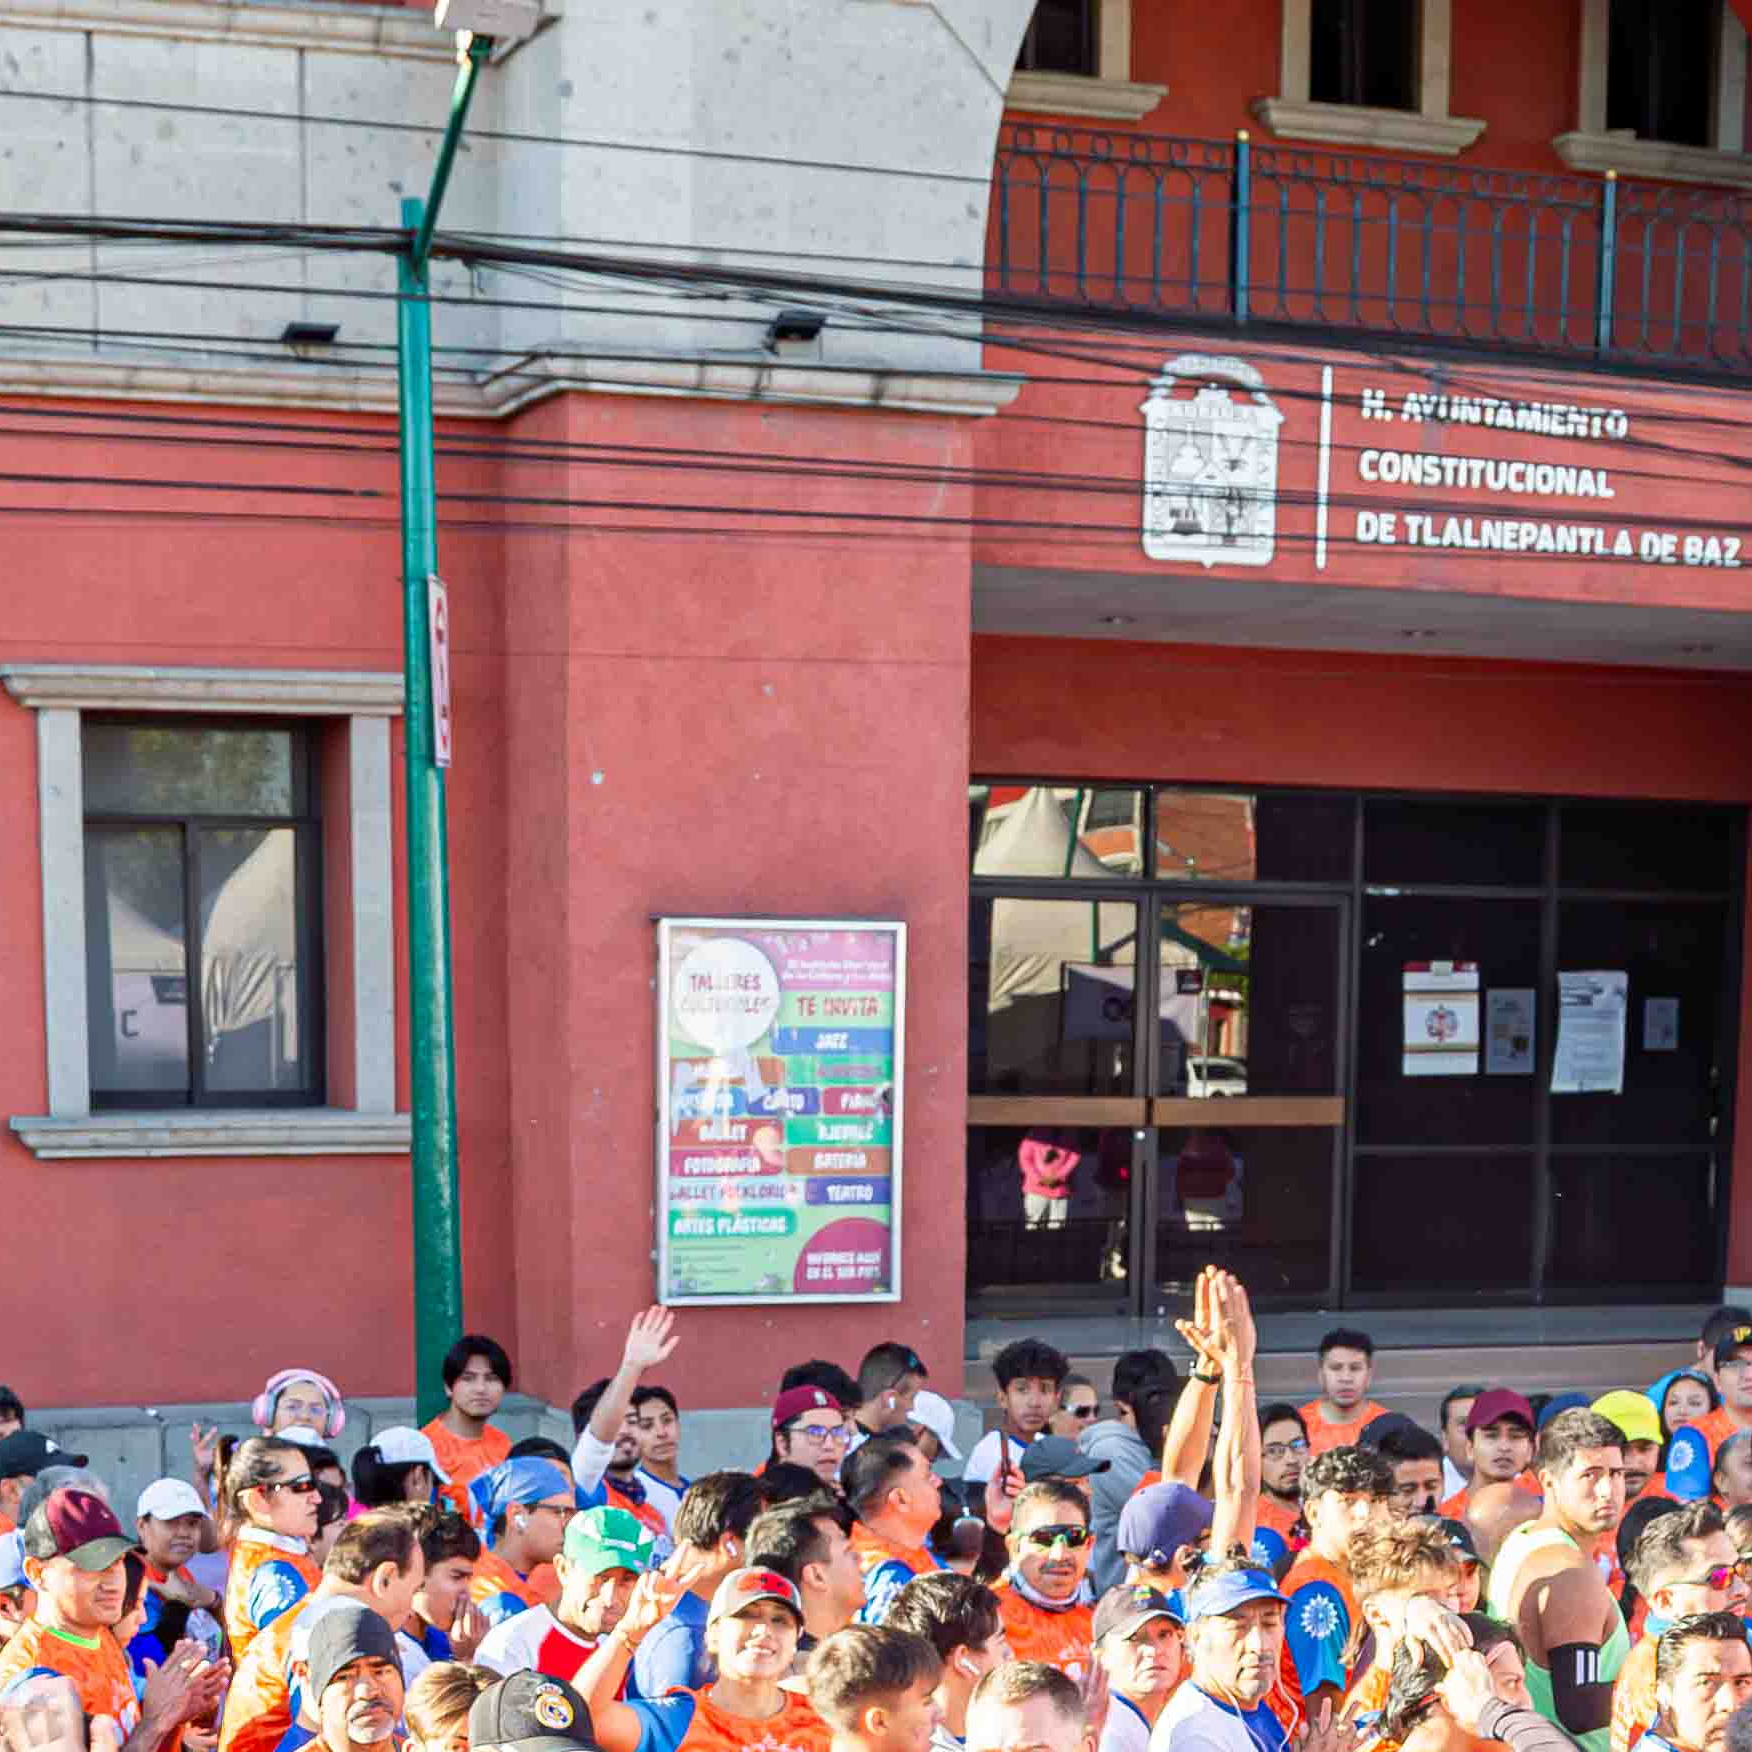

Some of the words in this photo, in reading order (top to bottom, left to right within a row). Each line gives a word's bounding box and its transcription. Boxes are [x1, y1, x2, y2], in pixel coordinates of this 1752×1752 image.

[1361, 388, 1393, 422] H.
[1400, 391, 1629, 438] AYUNTAMIENTO
[1359, 448, 1615, 498] CONSTITUCIONAL
[1356, 511, 1397, 544] DE
[1403, 514, 1634, 557] TLALNEPANTLA
[1639, 530, 1678, 564] DE
[1682, 534, 1743, 568] BAZ
